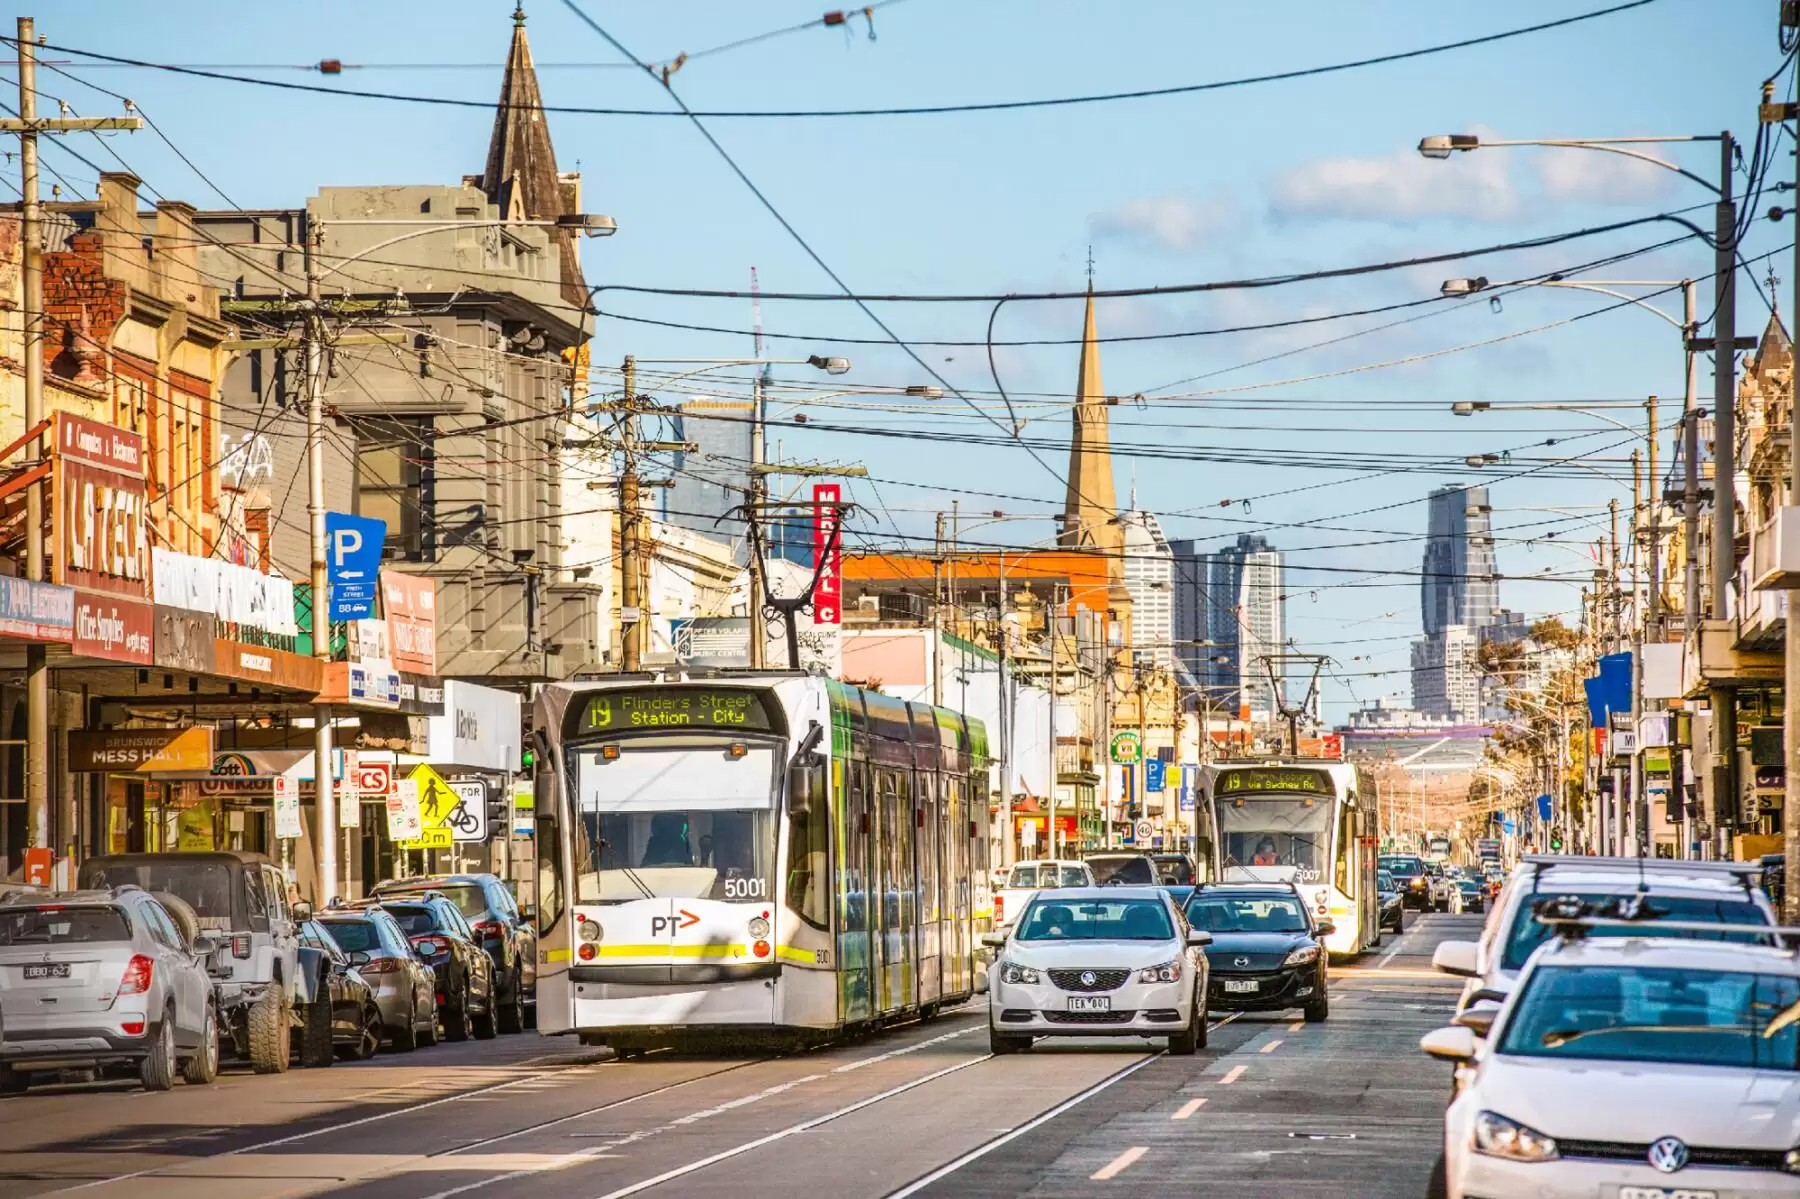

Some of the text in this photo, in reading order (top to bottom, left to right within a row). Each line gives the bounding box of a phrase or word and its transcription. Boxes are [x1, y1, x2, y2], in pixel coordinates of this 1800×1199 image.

[334, 529, 363, 566] P
[699, 694, 753, 709] Street
[591, 700, 611, 727] 19
[631, 711, 690, 725] Station
[713, 709, 745, 725] City
[92, 748, 184, 764] MESS HALL
[1227, 773, 1241, 789] 19
[462, 788, 480, 797] FOR
[1296, 869, 1321, 880] 5007
[724, 878, 766, 897] 5001
